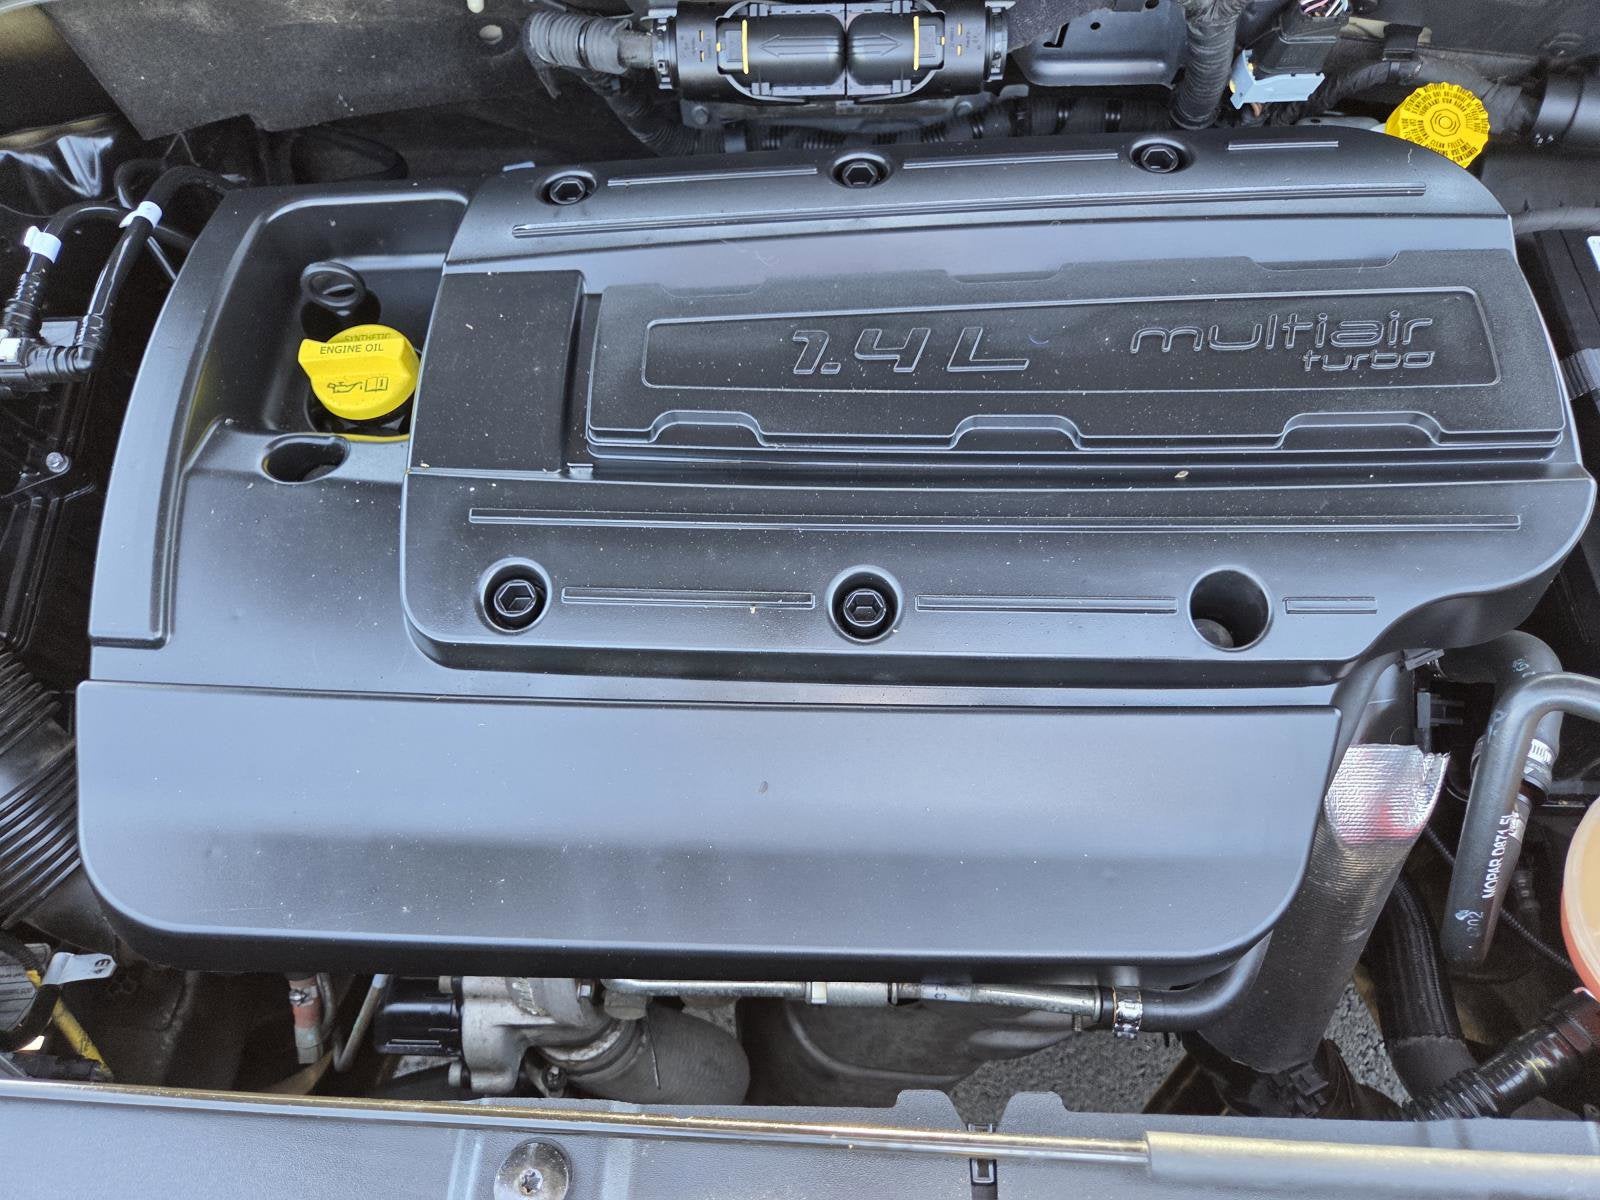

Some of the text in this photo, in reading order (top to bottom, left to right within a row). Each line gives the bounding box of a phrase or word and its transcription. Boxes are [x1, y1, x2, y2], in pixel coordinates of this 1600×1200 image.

[344, 332, 392, 342] SYNTHETIC
[1130, 309, 1433, 354] multiair
[319, 343, 385, 355] ENGINE OIL
[1303, 349, 1436, 372] turbo
[1482, 857, 1503, 899] MOPAR
